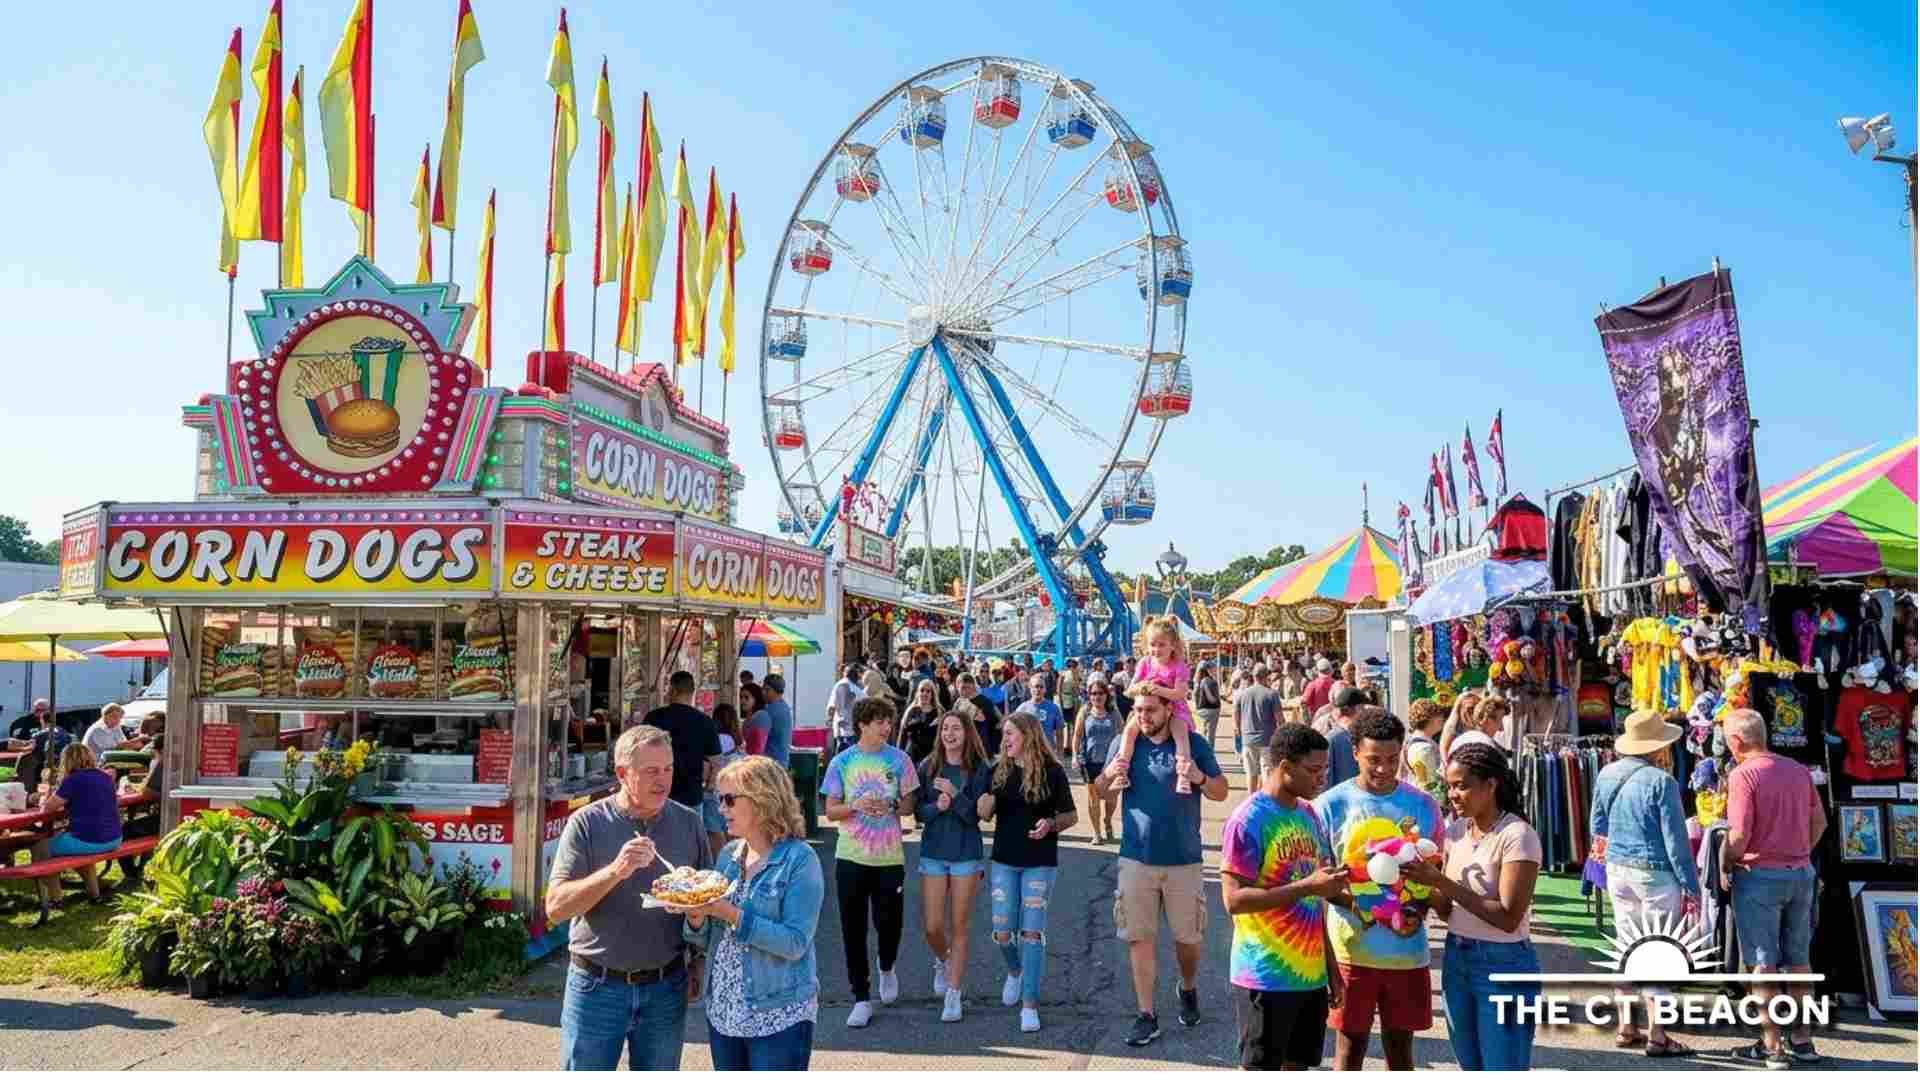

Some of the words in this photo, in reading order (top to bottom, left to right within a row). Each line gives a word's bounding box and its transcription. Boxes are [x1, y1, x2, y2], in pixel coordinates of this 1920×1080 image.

[586, 431, 656, 498] CORN
[663, 457, 716, 513] DOGS
[108, 529, 288, 585] CORN
[303, 528, 484, 582] DOGS
[537, 530, 647, 562] STEAK
[511, 560, 536, 588] &
[545, 562, 667, 592] CHEESE
[688, 543, 759, 597] CORN
[767, 559, 819, 601] DOGS
[442, 822, 505, 842] SAGE
